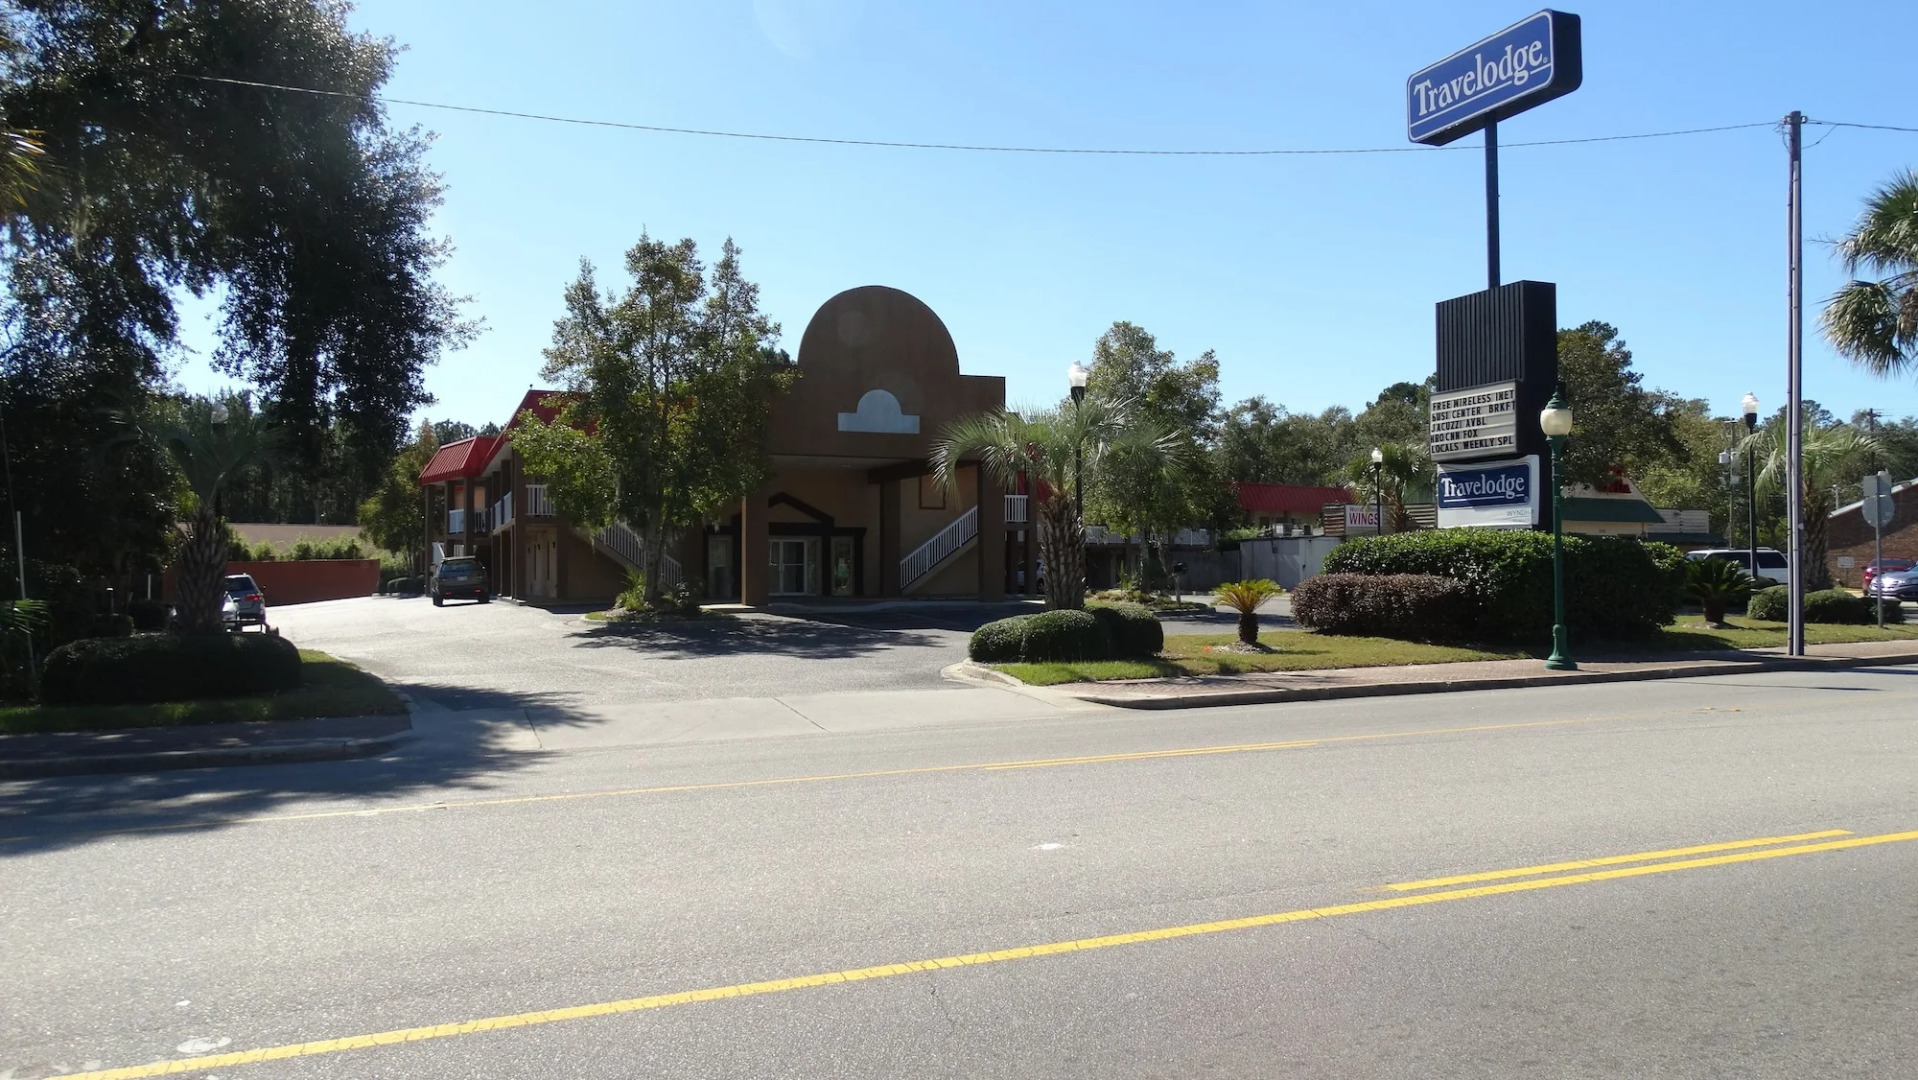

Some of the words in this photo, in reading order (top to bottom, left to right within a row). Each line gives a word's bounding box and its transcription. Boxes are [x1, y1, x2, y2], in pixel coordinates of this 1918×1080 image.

[1413, 40, 1543, 116] Travelodge
[1432, 401, 1451, 411] FREE
[1453, 394, 1491, 408] WIRELESS
[1495, 390, 1514, 401] INET
[1451, 406, 1481, 419] CENTER
[1431, 420, 1462, 433] JACUZZI
[1465, 417, 1487, 428] AVBL
[1463, 429, 1478, 439] FOX
[1431, 442, 1459, 454] LOCALS
[1463, 437, 1495, 450] WEEKLY
[1497, 435, 1513, 446] SPL
[1440, 473, 1525, 499] Travelodge
[1349, 512, 1379, 526] WINGS
